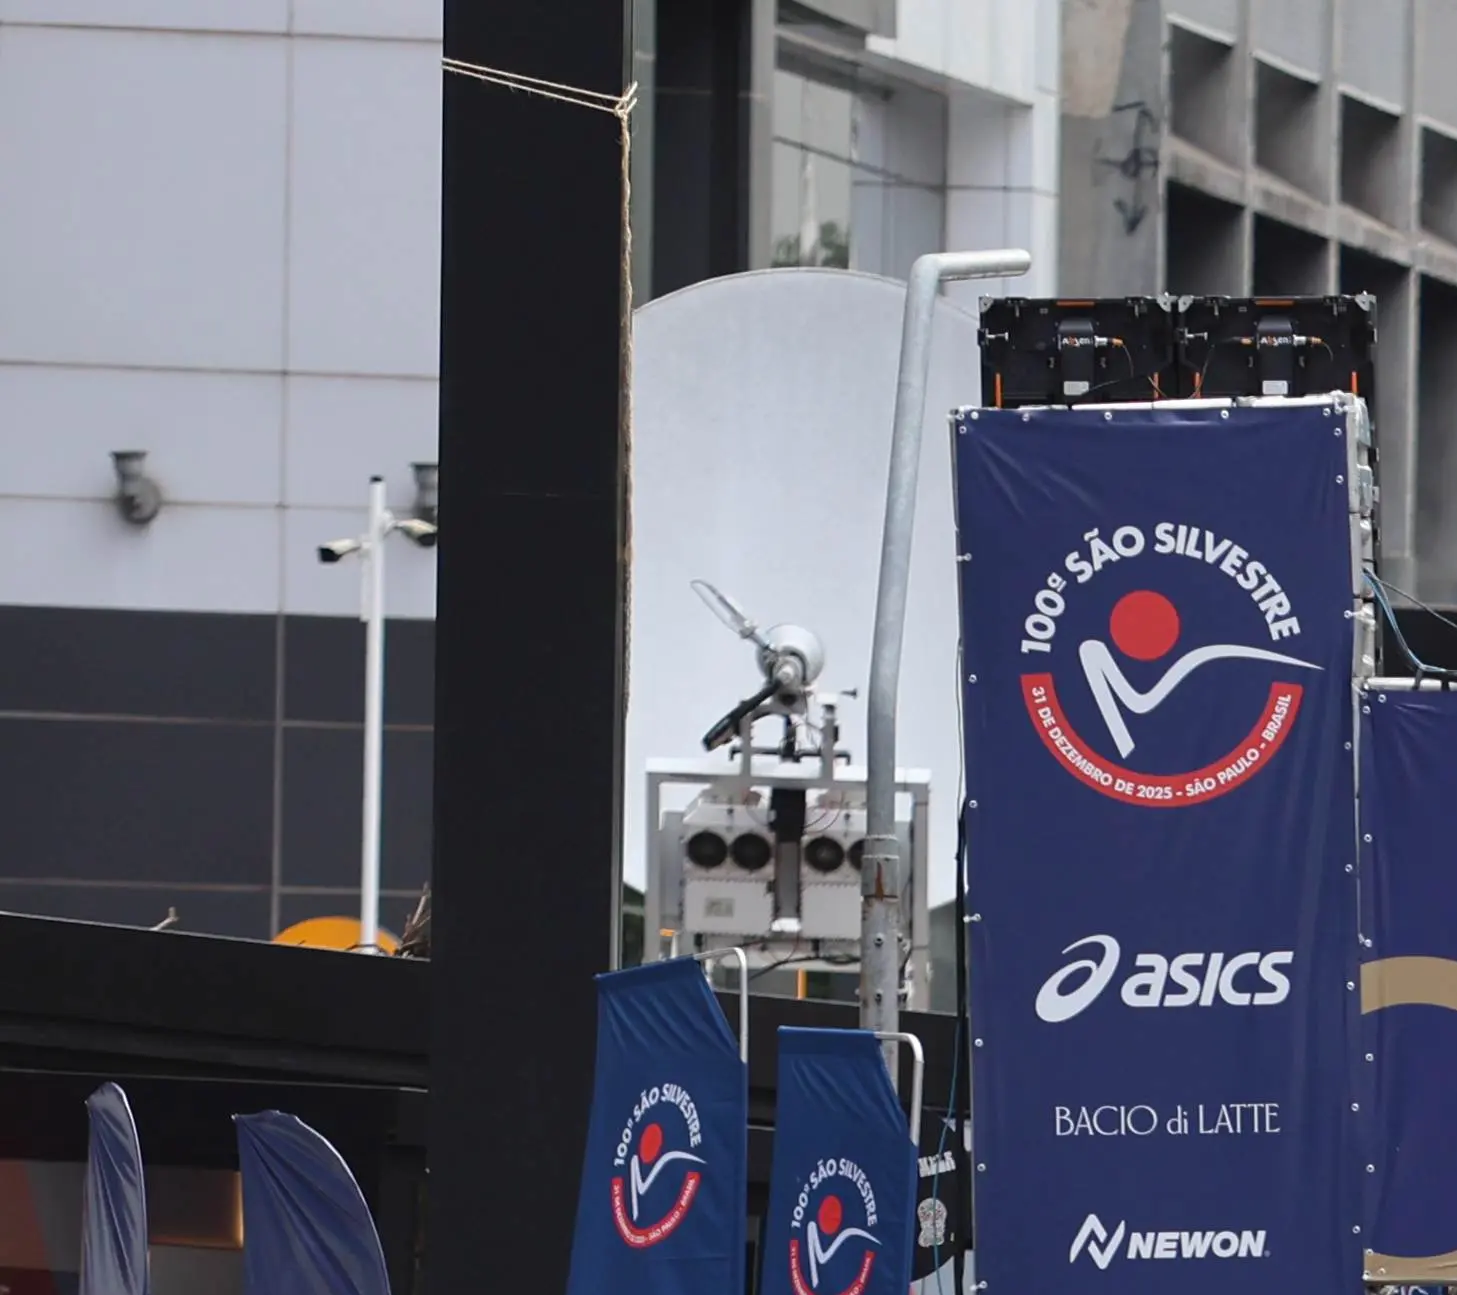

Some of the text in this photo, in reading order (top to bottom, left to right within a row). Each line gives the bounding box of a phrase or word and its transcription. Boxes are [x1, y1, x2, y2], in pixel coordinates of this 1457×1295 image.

[1020, 522, 1300, 654] 100ª SÃO SILVESTRE
[1054, 1103, 1281, 1137] BACIO di LATTE
[1127, 1229, 1266, 1260] NEWON
